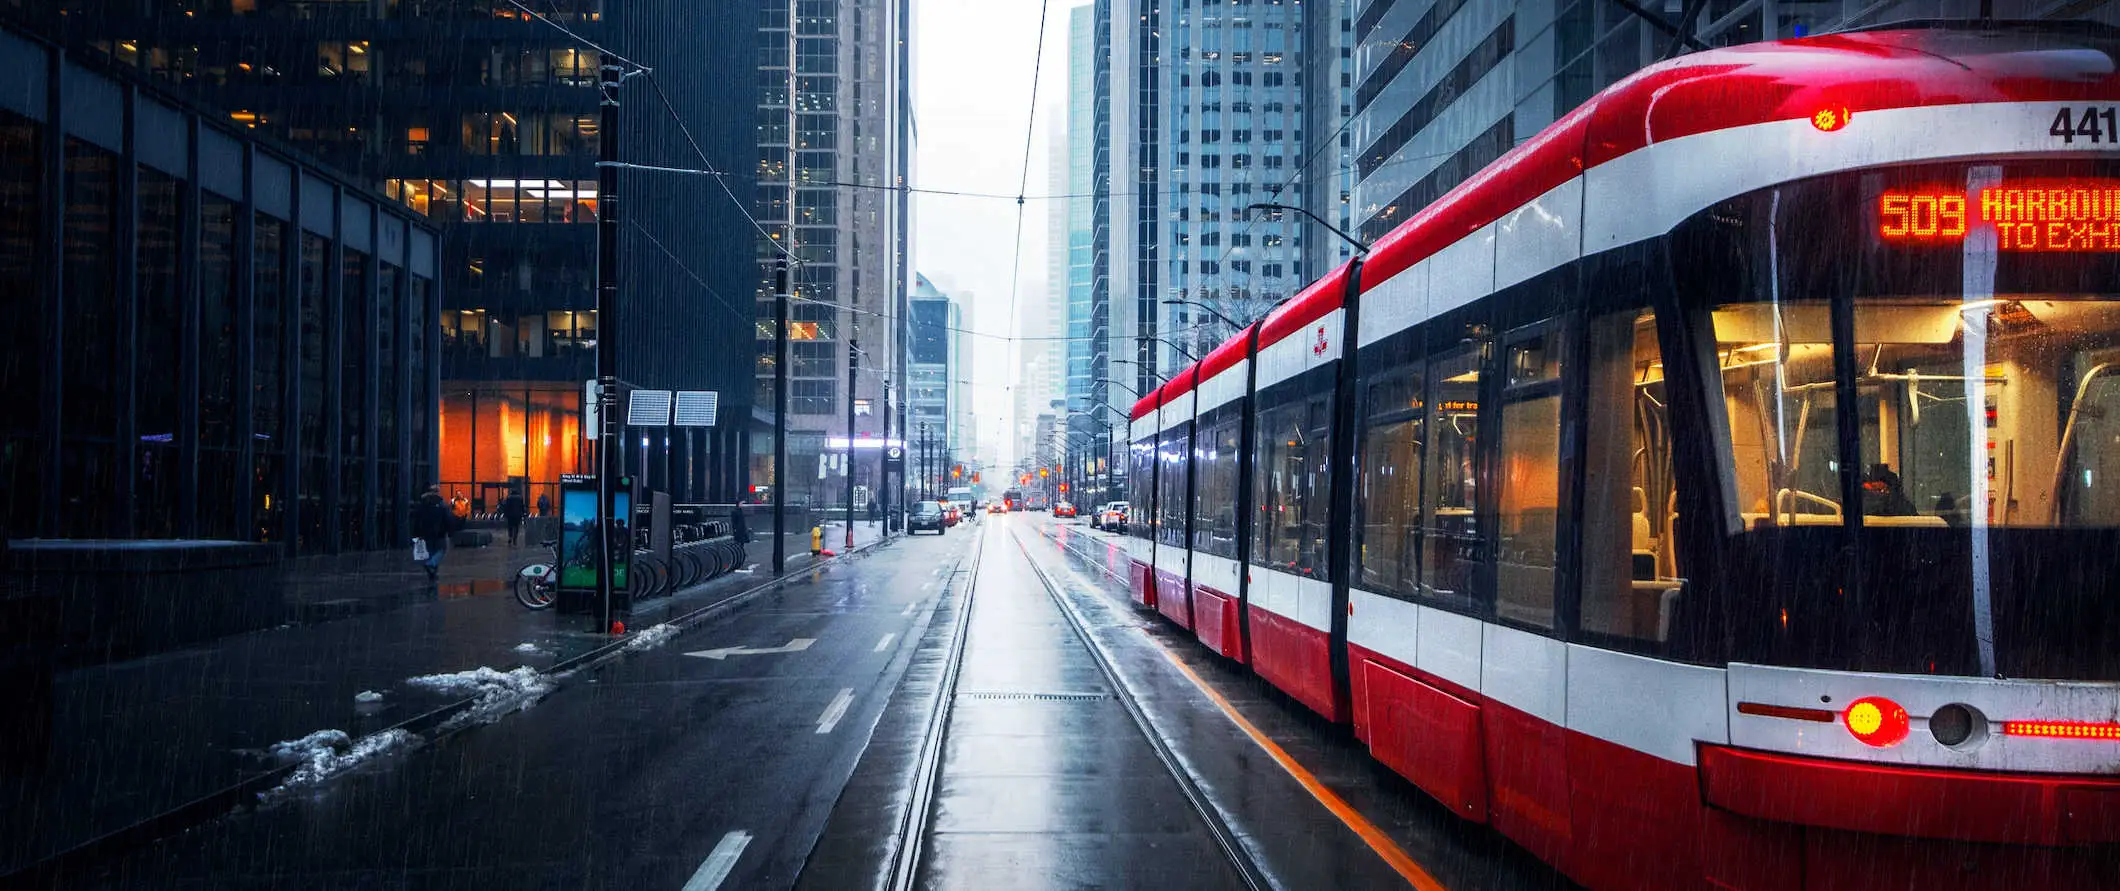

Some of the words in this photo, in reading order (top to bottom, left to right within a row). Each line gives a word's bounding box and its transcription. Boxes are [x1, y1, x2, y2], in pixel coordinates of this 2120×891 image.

[2049, 107, 2118, 143] 441
[1882, 195, 1966, 236] 509
[1997, 223, 2037, 248] TO
[2048, 222, 2120, 248] EXHI
